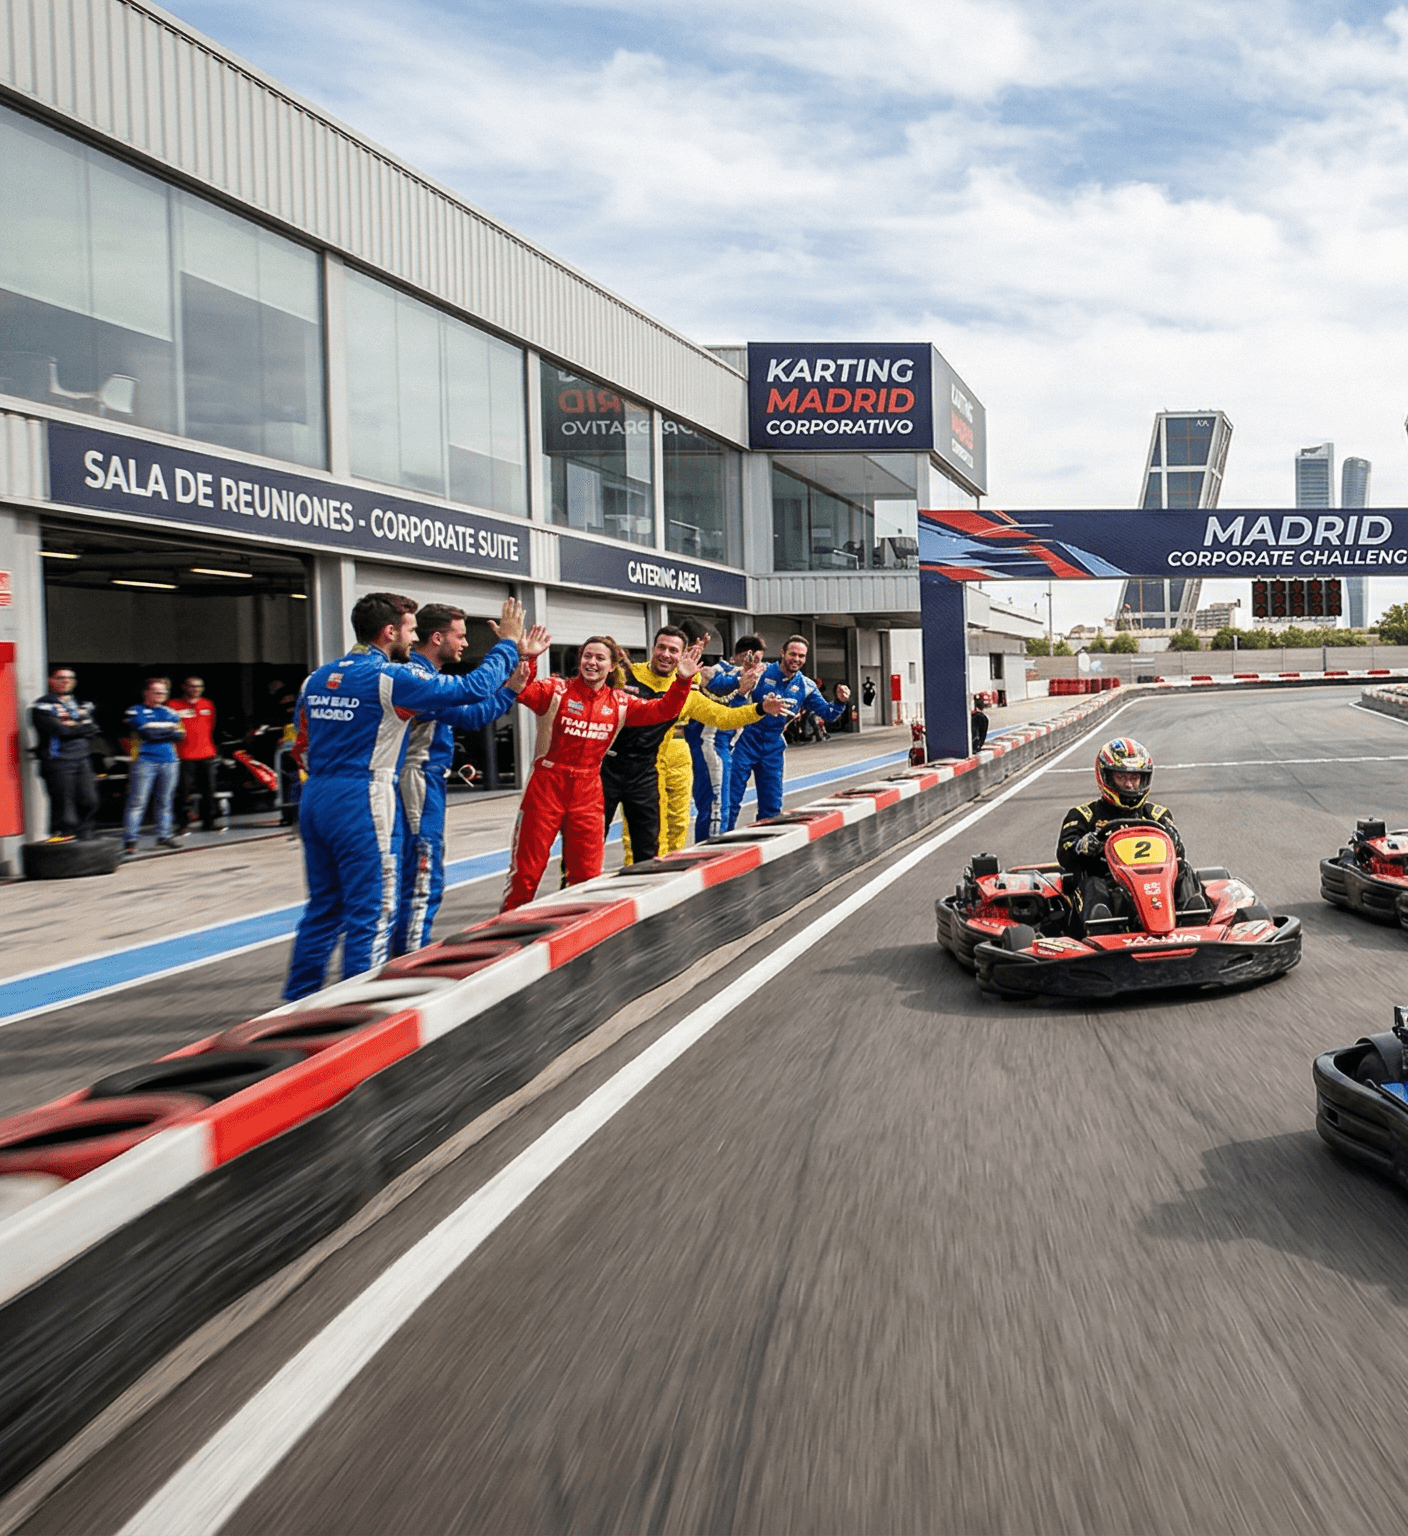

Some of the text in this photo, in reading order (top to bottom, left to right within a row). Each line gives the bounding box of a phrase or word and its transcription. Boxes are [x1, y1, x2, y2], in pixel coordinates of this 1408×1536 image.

[766, 358, 915, 383] KARTING
[765, 387, 915, 414] MADRID
[765, 419, 914, 436] CORPORATIVO
[83, 449, 520, 562] SALA DE REUNIONES - CORPORATE SUITE
[1203, 515, 1393, 547] MADRID
[1167, 549, 1295, 567] CORPORATE
[627, 560, 677, 590] CATERING
[1134, 841, 1151, 860] 2
